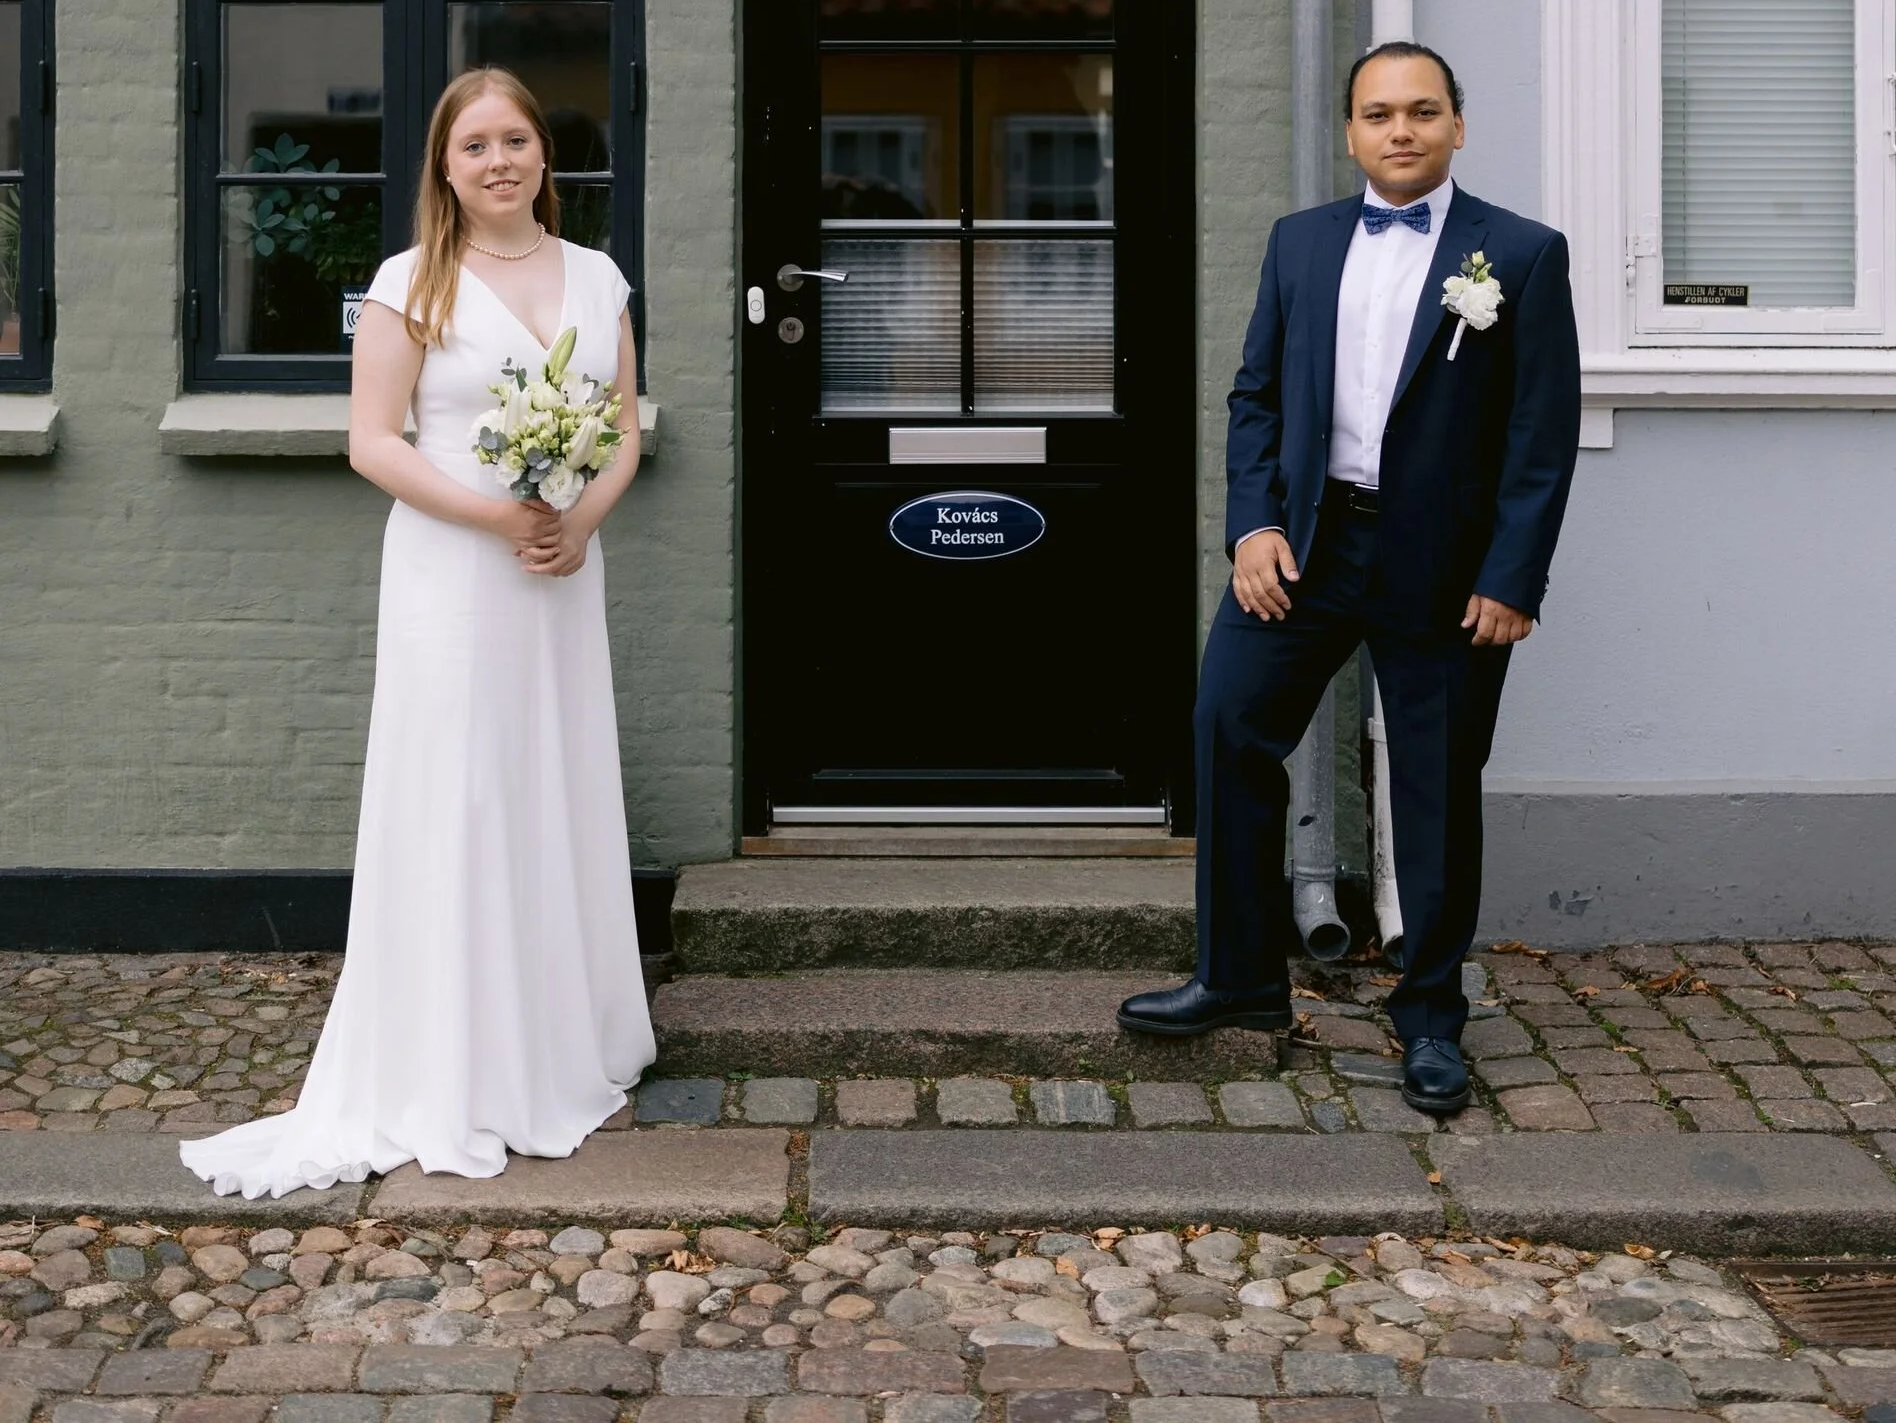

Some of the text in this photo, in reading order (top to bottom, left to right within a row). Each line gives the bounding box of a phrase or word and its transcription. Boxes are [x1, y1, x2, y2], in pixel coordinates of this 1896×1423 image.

[1667, 286, 1745, 296] HENSTILLEN AF CYKLER
[937, 507, 998, 523] Kovács
[931, 529, 1004, 544] Pedersen
